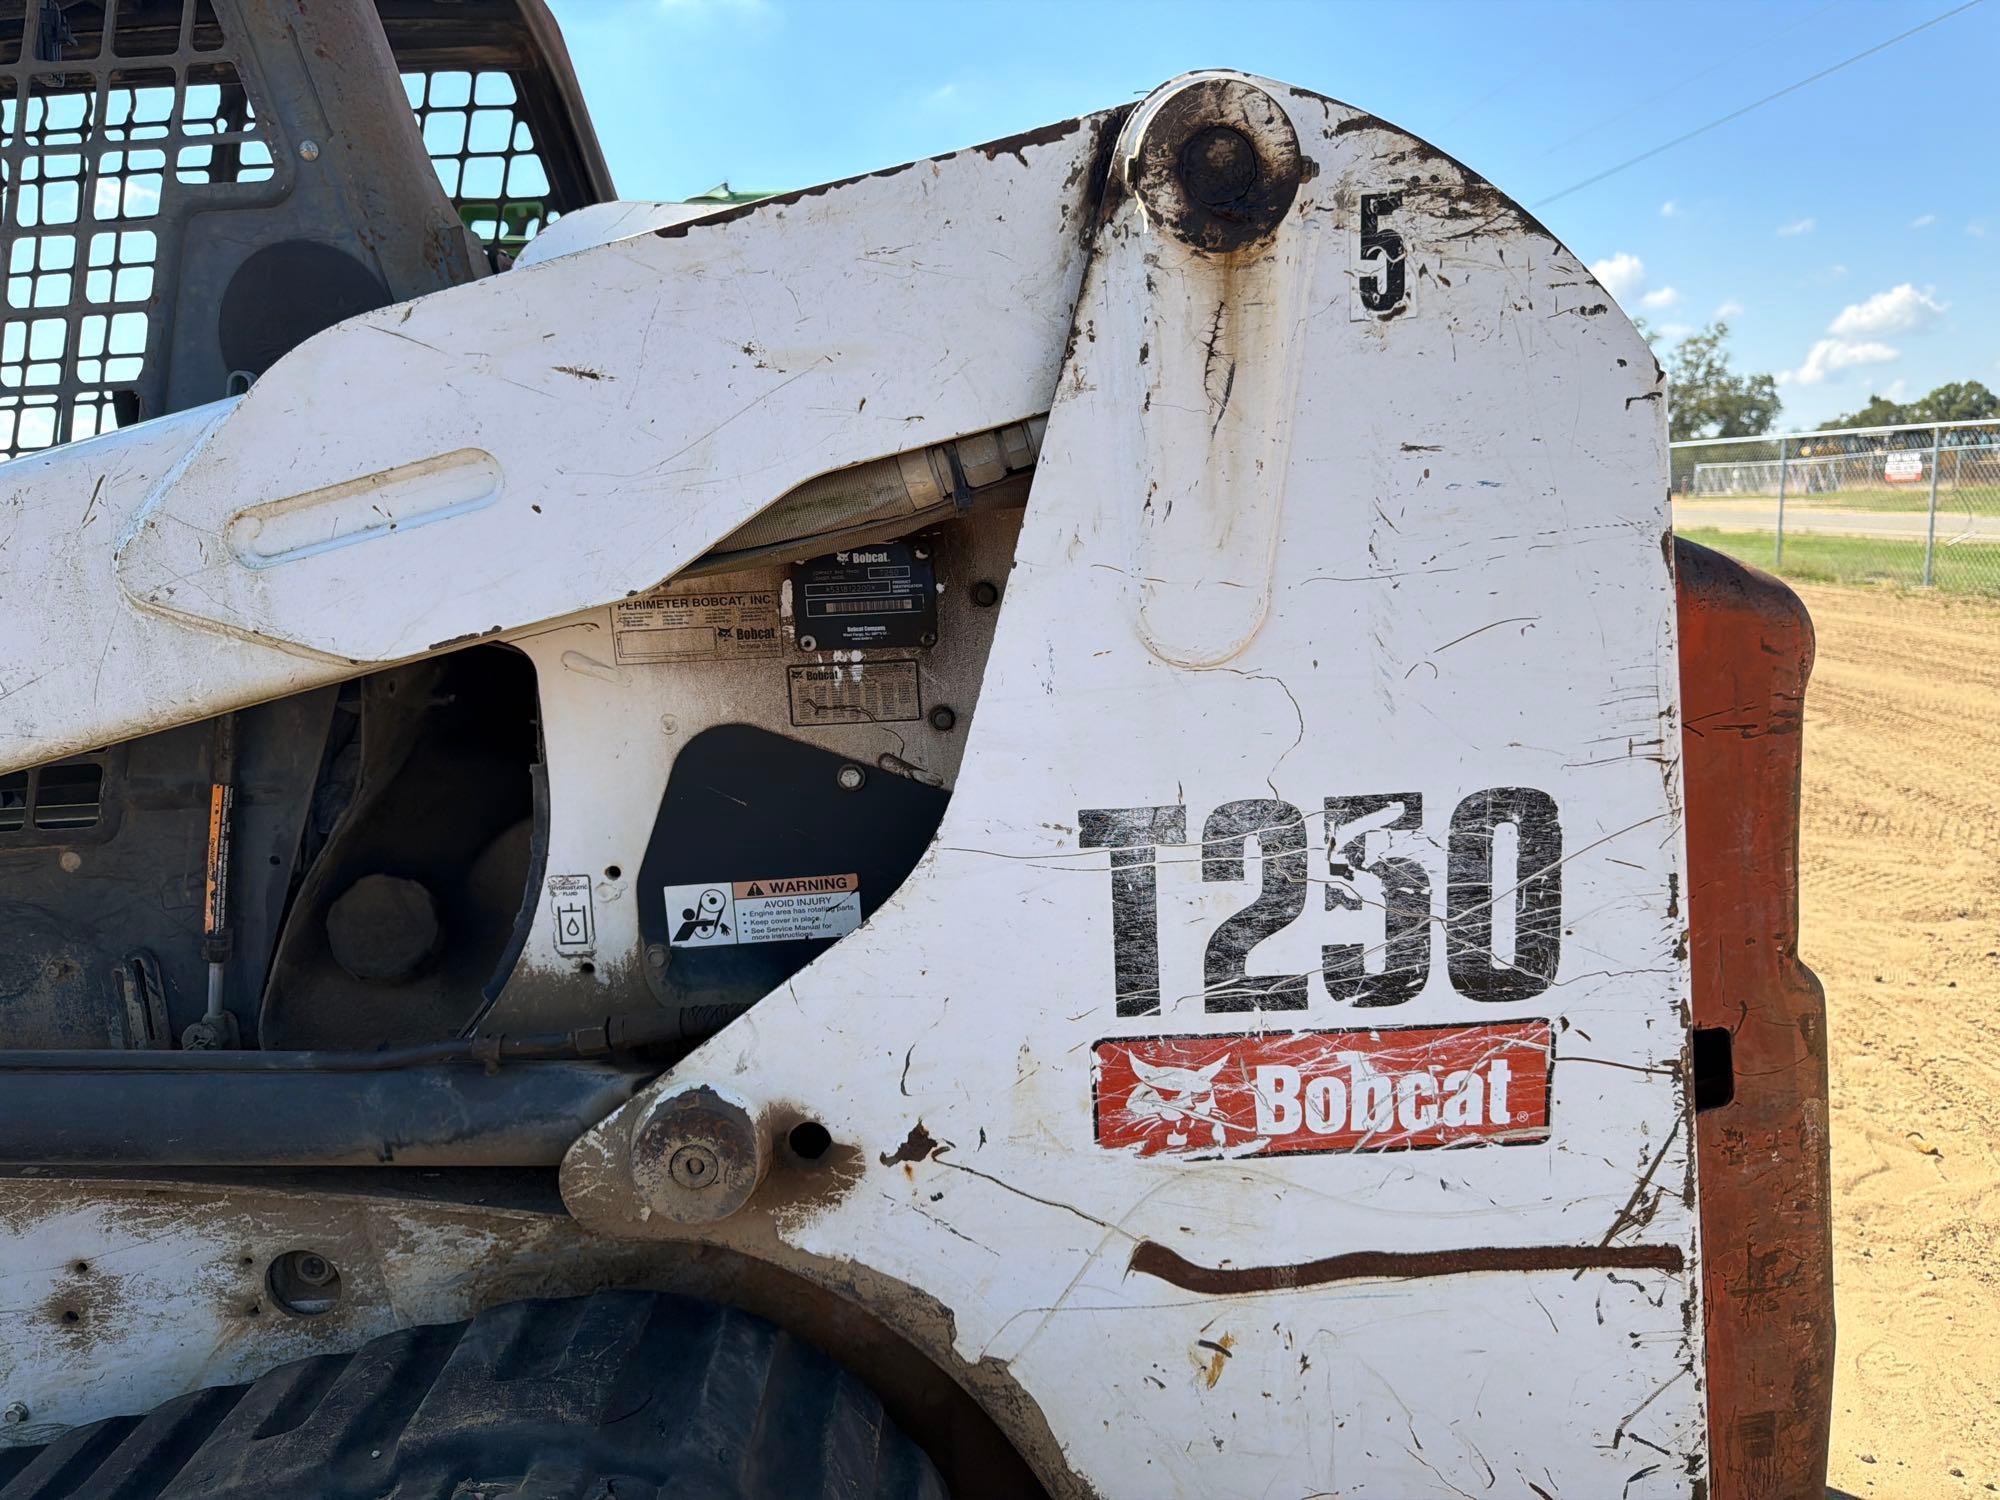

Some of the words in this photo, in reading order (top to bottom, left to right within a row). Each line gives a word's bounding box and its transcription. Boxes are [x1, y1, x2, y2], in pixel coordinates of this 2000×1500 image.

[1359, 190, 1405, 311] 5
[852, 552, 888, 563] Bobcat
[617, 599, 688, 611] PERIMETER
[692, 596, 746, 608] BOBCAT,
[750, 594, 775, 605] INC.
[736, 628, 775, 640] Bobcat
[806, 670, 839, 681] Bobcat
[769, 877, 848, 894] WARNING
[764, 899, 794, 909] AVOID
[796, 896, 832, 907] INJURY
[1078, 786, 1562, 1017] T250
[749, 910, 774, 919] Engine
[807, 905, 834, 913] rotating
[836, 904, 856, 913] parts.
[750, 919, 769, 927] Keep
[800, 916, 820, 925] place.
[766, 925, 793, 933] Service
[794, 923, 821, 931] Manual
[771, 931, 815, 940] instructions.
[1254, 1052, 1512, 1136] Bobcat
